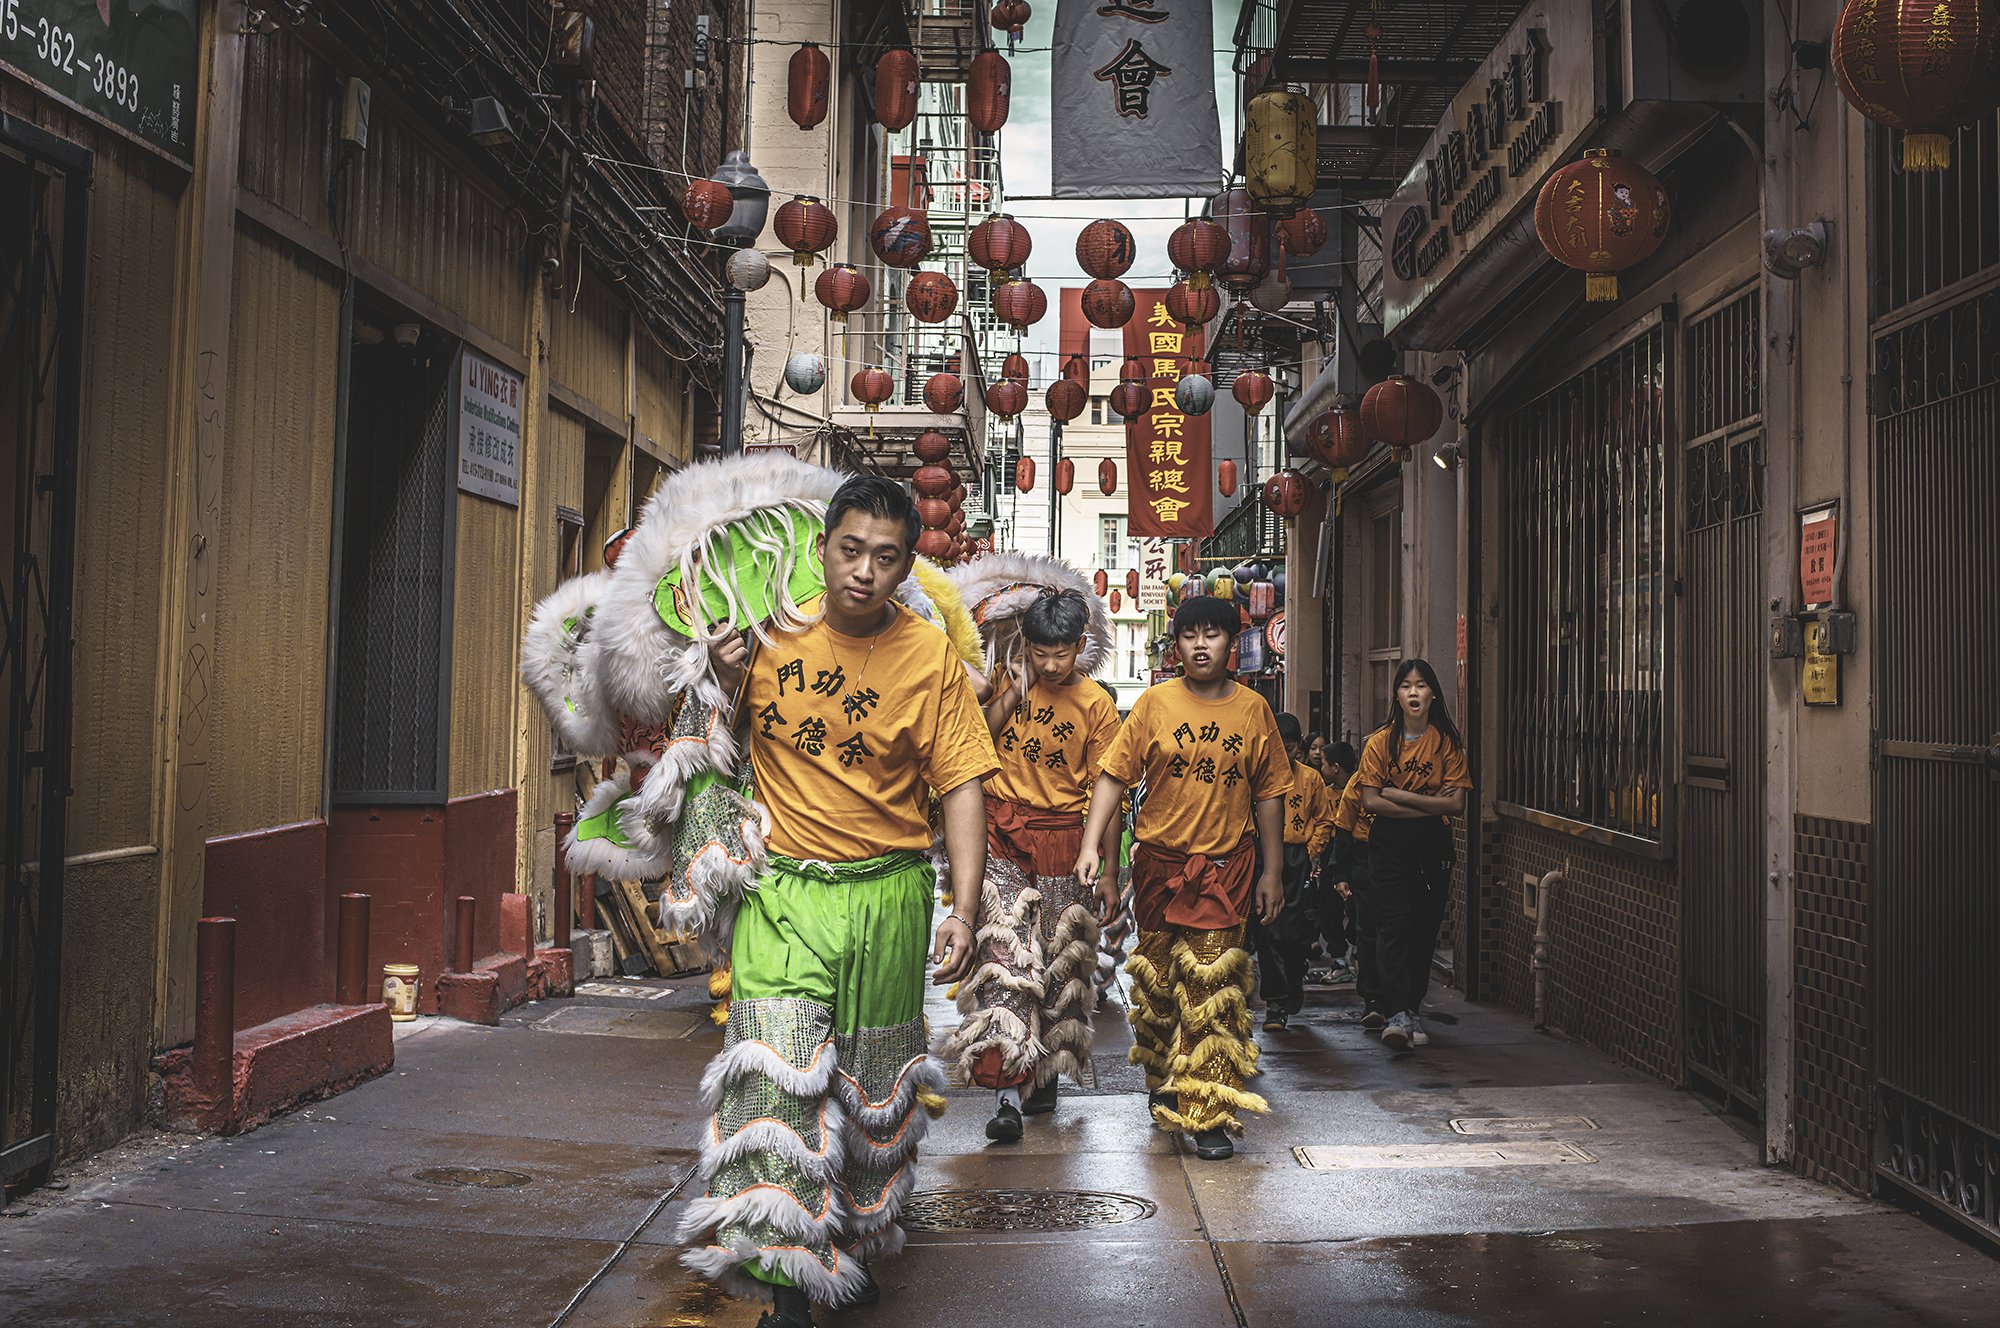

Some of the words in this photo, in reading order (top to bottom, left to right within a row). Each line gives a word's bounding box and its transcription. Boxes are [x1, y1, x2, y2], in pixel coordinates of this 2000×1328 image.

[1093, 0, 1172, 119] 會
[1415, 226, 1449, 277] CHINESE
[1452, 166, 1501, 235] CHRISTIAN
[1507, 101, 1556, 177] MISSION
[1564, 179, 1588, 248] 大吉大利
[469, 359, 478, 389] LI
[479, 363, 499, 399] YING
[1147, 301, 1191, 523] 美國馬氏宗親總會
[468, 425, 514, 467] 承接修改成衣
